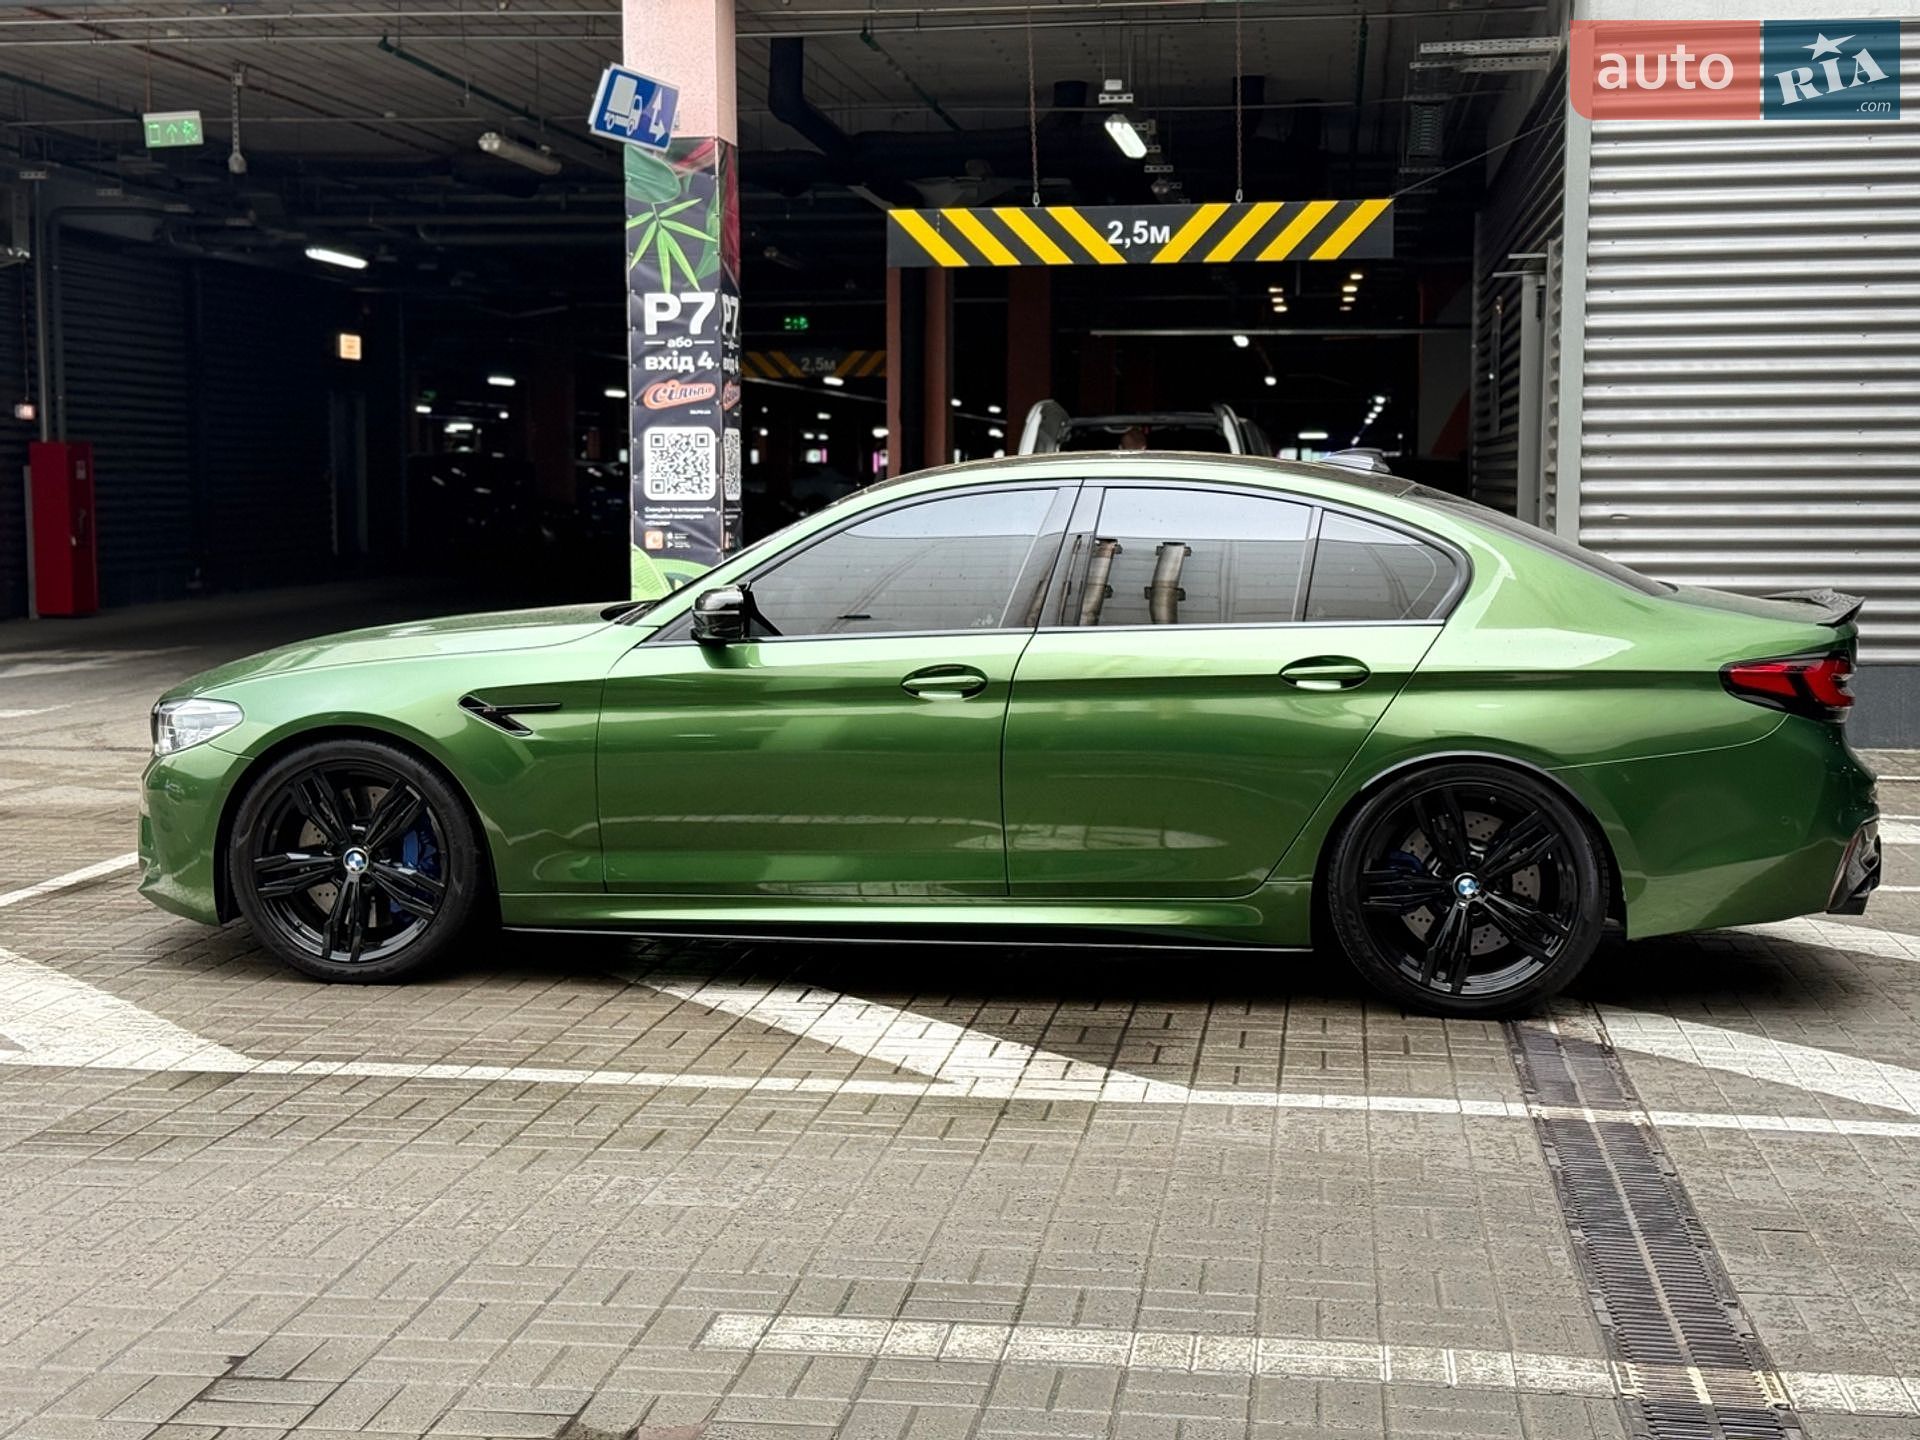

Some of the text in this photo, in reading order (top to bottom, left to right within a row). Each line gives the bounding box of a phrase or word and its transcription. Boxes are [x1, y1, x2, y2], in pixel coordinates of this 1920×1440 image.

[1107, 220, 1170, 249] 2,5м
[644, 292, 716, 335] P7
[667, 336, 693, 348] або
[645, 350, 695, 373] вхід
[697, 351, 715, 370] 4
